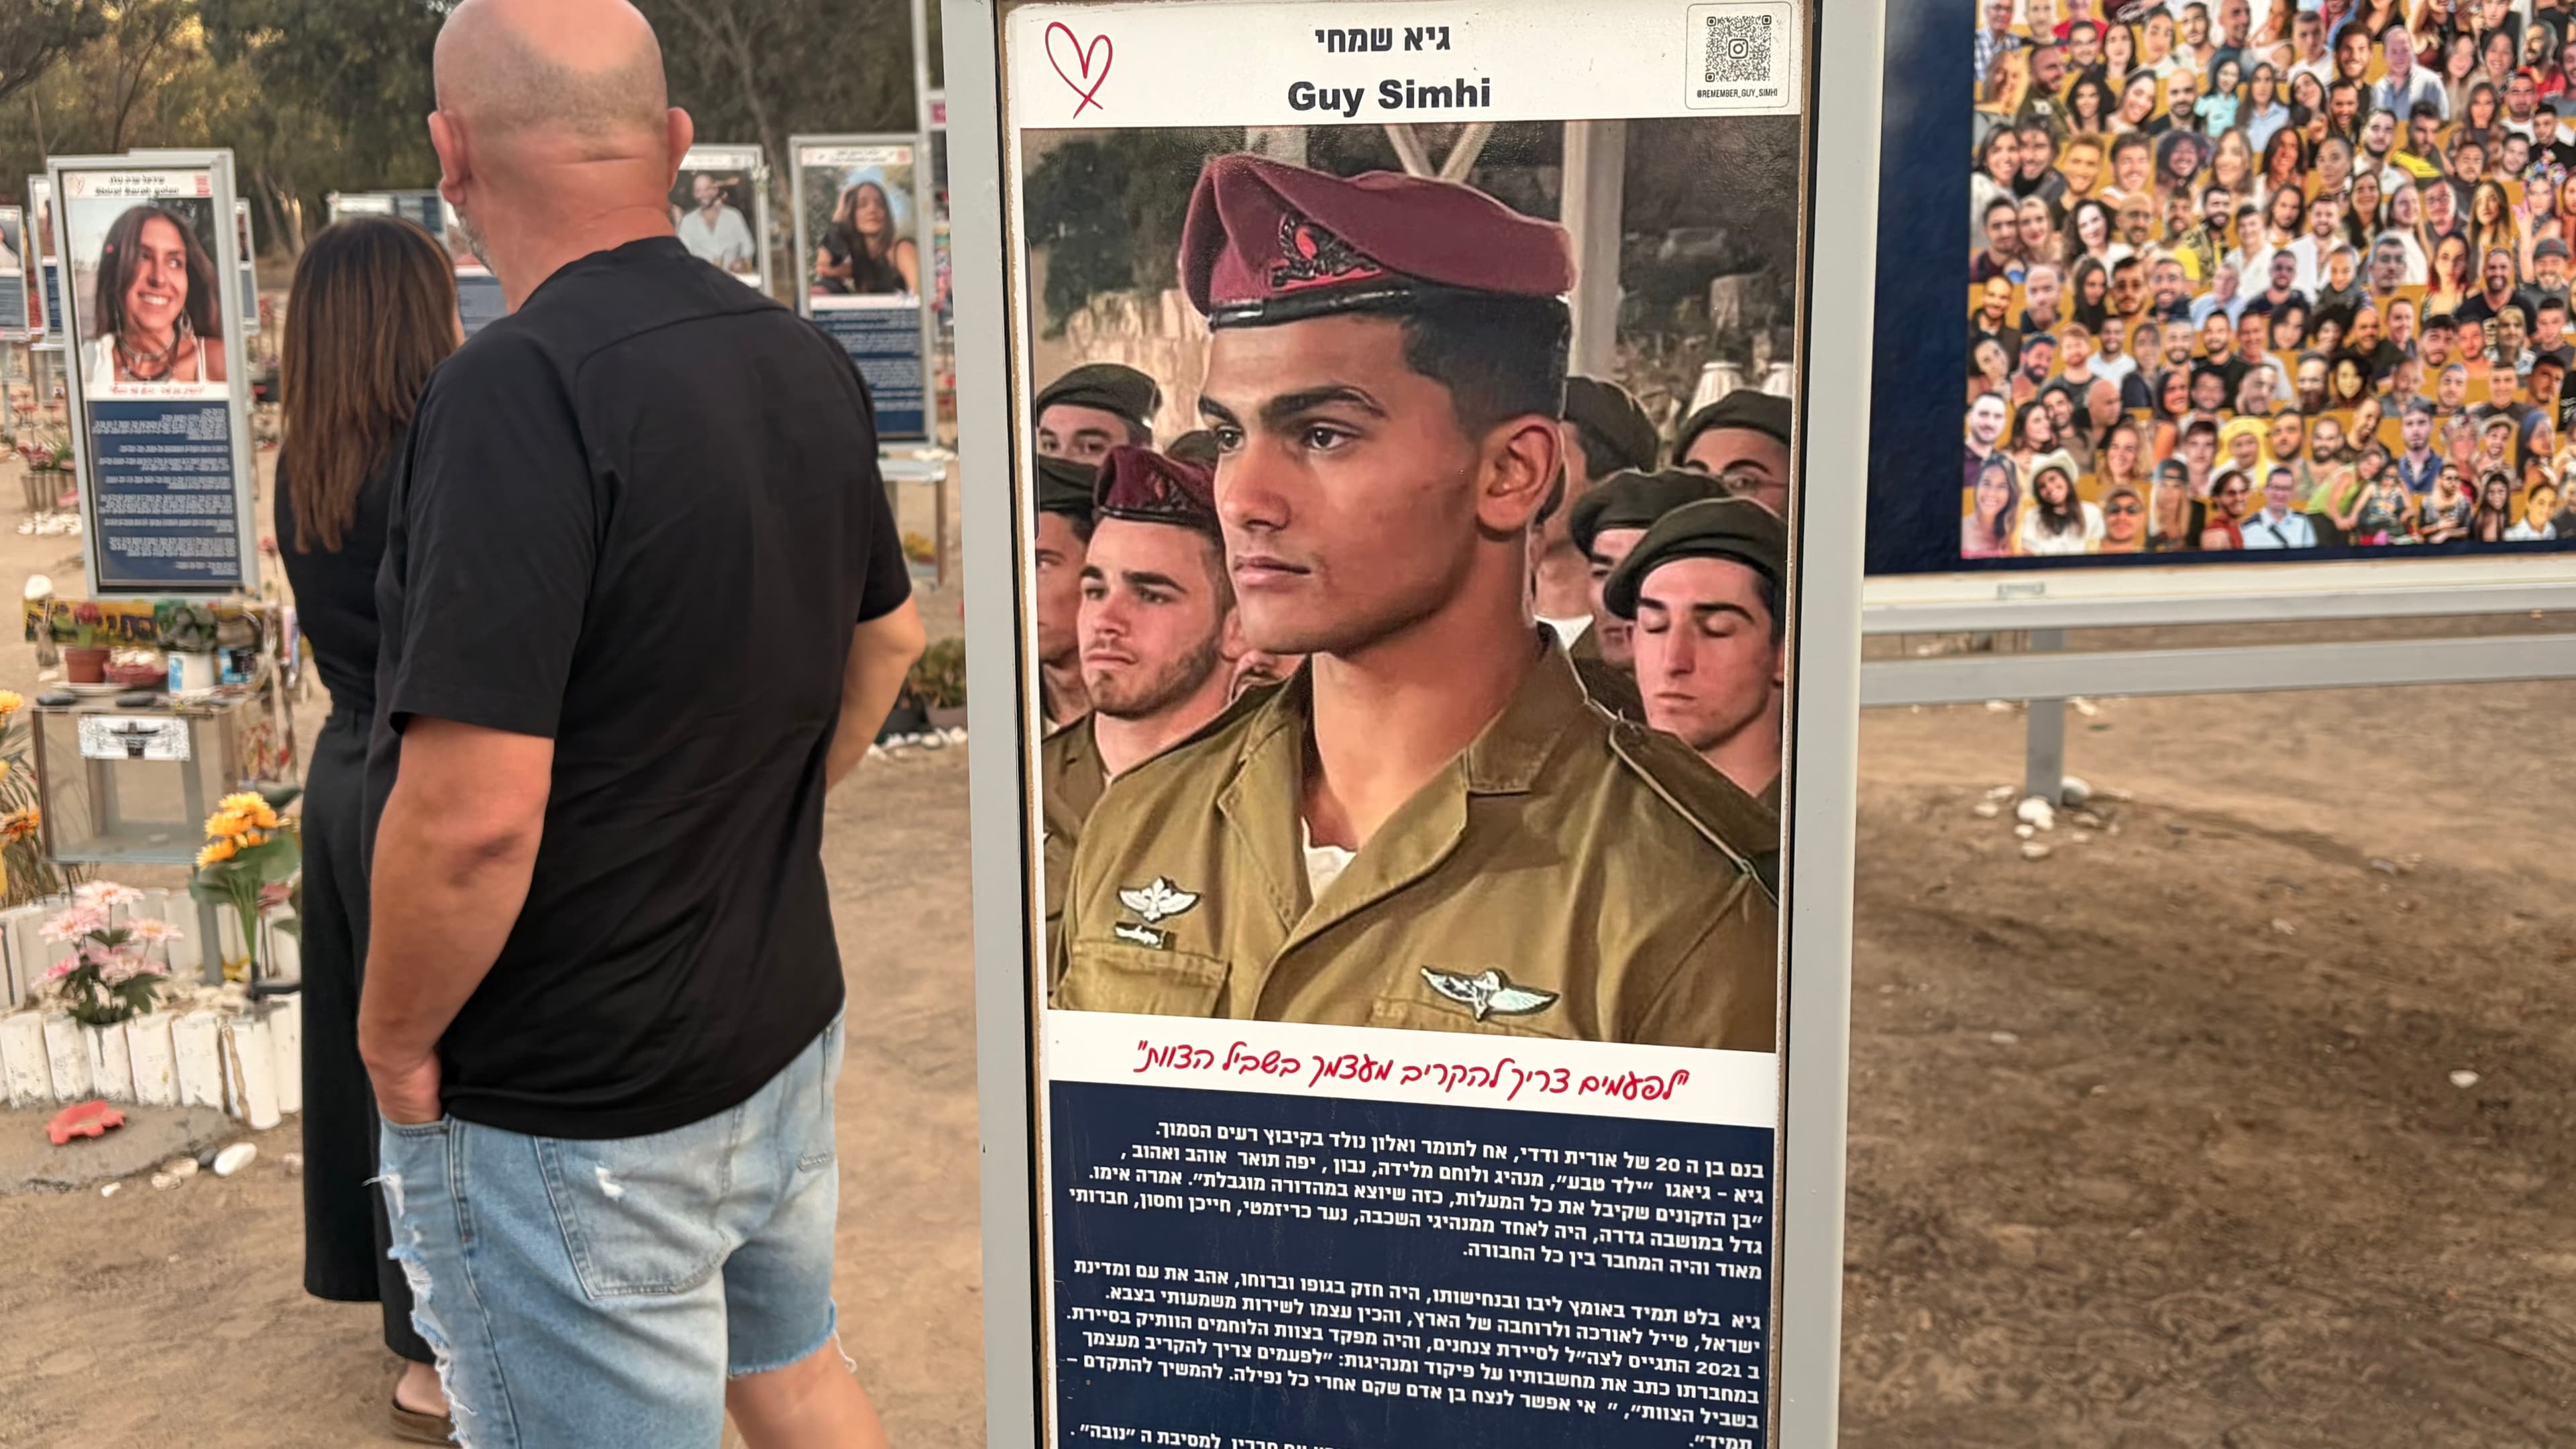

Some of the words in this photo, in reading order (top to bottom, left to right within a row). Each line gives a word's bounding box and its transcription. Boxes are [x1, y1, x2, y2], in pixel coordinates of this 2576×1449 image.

[1315, 28, 1393, 53] שמחי
[1404, 26, 1450, 51] גיא
[1288, 80, 1364, 117] Guy
[1378, 78, 1490, 109] Simhi
[1697, 88, 1778, 99] @REMEMBER_GUY_SIMHI
[1133, 1040, 1214, 1073] הצוות"
[1222, 1040, 1301, 1077] בשביל
[1308, 1054, 1393, 1087] מעצמך
[1400, 1057, 1515, 1093] להקריב
[1507, 1068, 1570, 1101] צריך
[1578, 1069, 1690, 1101] "לפעמים
[1155, 1122, 1212, 1139] הסמוך.
[1217, 1126, 1258, 1142] רעים
[1263, 1128, 1324, 1148] בקיבוץ
[1328, 1130, 1366, 1149] נולד
[1132, 1144, 1180, 1161] ואהוב
[1371, 1134, 1416, 1153] ואלון
[1421, 1139, 1477, 1157] לתומר
[1483, 1144, 1507, 1160] אח
[1185, 1148, 1227, 1165] אוהב
[1236, 1151, 1280, 1168] תואר
[1285, 1155, 1316, 1170] יפה
[1513, 1146, 1559, 1164] ודדי,
[1564, 1150, 1617, 1168] אורית
[1623, 1150, 1650, 1170] של
[1089, 1165, 1130, 1182] אימו.
[1333, 1158, 1366, 1175] נבון
[1371, 1160, 1434, 1179] מלידה,
[1439, 1165, 1489, 1183] ולוחם
[1655, 1157, 1680, 1173] 20
[1686, 1159, 1699, 1174] ה
[1704, 1160, 1725, 1178] בן
[1730, 1162, 1764, 1179] בנם
[1135, 1169, 1183, 1185] אמרה
[1493, 1170, 1544, 1187] מנהיג
[1069, 1188, 1128, 1205] חברותי
[1271, 1178, 1349, 1197] במהדורה
[1354, 1184, 1406, 1201] שיוצא
[1411, 1188, 1444, 1205] כזה
[1664, 1183, 1711, 1200] גיאגו
[1733, 1188, 1764, 1204] גיא
[1133, 1193, 1183, 1210] וחסון,
[1187, 1196, 1231, 1214] חייכן
[1236, 1200, 1312, 1219] כריזמטי,
[1448, 1190, 1525, 1211] המעלות,
[1529, 1194, 1553, 1213] כל
[1558, 1199, 1585, 1216] את
[1316, 1205, 1348, 1222] נער
[1353, 1209, 1421, 1228] השכבה,
[1590, 1199, 1650, 1222] שקיבל
[1655, 1208, 1726, 1228] הזקונים
[1426, 1214, 1495, 1234] ממנהיגי
[1500, 1220, 1550, 1238] לאחד
[1554, 1224, 1587, 1241] היה
[1592, 1228, 1645, 1246] גדרה,
[1650, 1232, 1724, 1252] במושבה
[1729, 1235, 1763, 1255] גדל
[1462, 1242, 1536, 1262] החבורה.
[1540, 1244, 1564, 1264] כל
[1568, 1250, 1597, 1268] בין
[1073, 1259, 1131, 1277] ומדינת
[1601, 1253, 1664, 1272] המחבר
[1669, 1258, 1710, 1276] והיה
[1715, 1263, 1762, 1280] מאוד
[1136, 1265, 1159, 1279] עם
[1164, 1267, 1189, 1282] את
[1193, 1269, 1229, 1285] אהב
[1234, 1273, 1295, 1291] וברוחו,
[1299, 1277, 1346, 1295] בגופו
[1350, 1281, 1384, 1299] חזק
[1105, 1286, 1156, 1303] בצבא.
[1160, 1290, 1237, 1309] משמעותי
[1389, 1285, 1421, 1301] היה
[1426, 1289, 1520, 1309] ובנחישותו,
[1241, 1297, 1305, 1316] לשירות
[1309, 1302, 1352, 1319] עצמו
[1525, 1295, 1563, 1313] ליבו
[1568, 1300, 1626, 1319] באומץ
[1066, 1306, 1132, 1324] בסיירת.
[1135, 1311, 1192, 1330] הוותיק
[1357, 1306, 1401, 1324] והכין
[1407, 1311, 1460, 1329] הארץ,
[1466, 1312, 1492, 1332] של
[1630, 1305, 1678, 1323] תמיד
[1683, 1307, 1721, 1327] בלט
[1731, 1313, 1761, 1330] גיא
[1197, 1317, 1269, 1336] הלוחמים
[1273, 1324, 1324, 1341] בצוות
[1497, 1318, 1570, 1338] ולרוחבה
[1576, 1326, 1644, 1344] לאורכה
[1082, 1331, 1140, 1349] מעצמך
[1144, 1336, 1208, 1355] להקריב
[1328, 1328, 1378, 1346] מפקד
[1383, 1333, 1421, 1350] והיה
[1648, 1328, 1688, 1348] טייל
[1694, 1333, 1760, 1354] ישראל,
[1212, 1342, 1252, 1359] צריך
[1426, 1338, 1491, 1356] צנחנים,
[1496, 1343, 1560, 1362] לסיירת
[1083, 1354, 1153, 1373] להתקדם
[1157, 1360, 1224, 1380] להמשיך
[1338, 1354, 1419, 1374] ומנהיגות:
[1424, 1360, 1475, 1379] פיקוד
[1480, 1362, 1503, 1381] על
[1628, 1354, 1690, 1374] התגייס
[1695, 1361, 1742, 1379] 2021
[1747, 1365, 1760, 1380] ב
[1228, 1365, 1283, 1385] נפילה.
[1287, 1369, 1309, 1387] כל
[1313, 1375, 1356, 1392] אחרי
[1508, 1368, 1595, 1390] מחשבותיו
[1361, 1379, 1401, 1397] שקם
[1406, 1383, 1442, 1400] אדם
[1601, 1377, 1627, 1393] את
[1632, 1380, 1670, 1396] כתב
[1676, 1383, 1760, 1405] במחברתו
[1447, 1387, 1467, 1404] בן
[1471, 1389, 1515, 1406] לנצח
[1519, 1393, 1571, 1412] אפשר
[1576, 1399, 1597, 1414] אי
[1699, 1407, 1759, 1429] בשביל
[1140, 1429, 1152, 1444] ה
[1157, 1431, 1222, 1449] למסיבת
